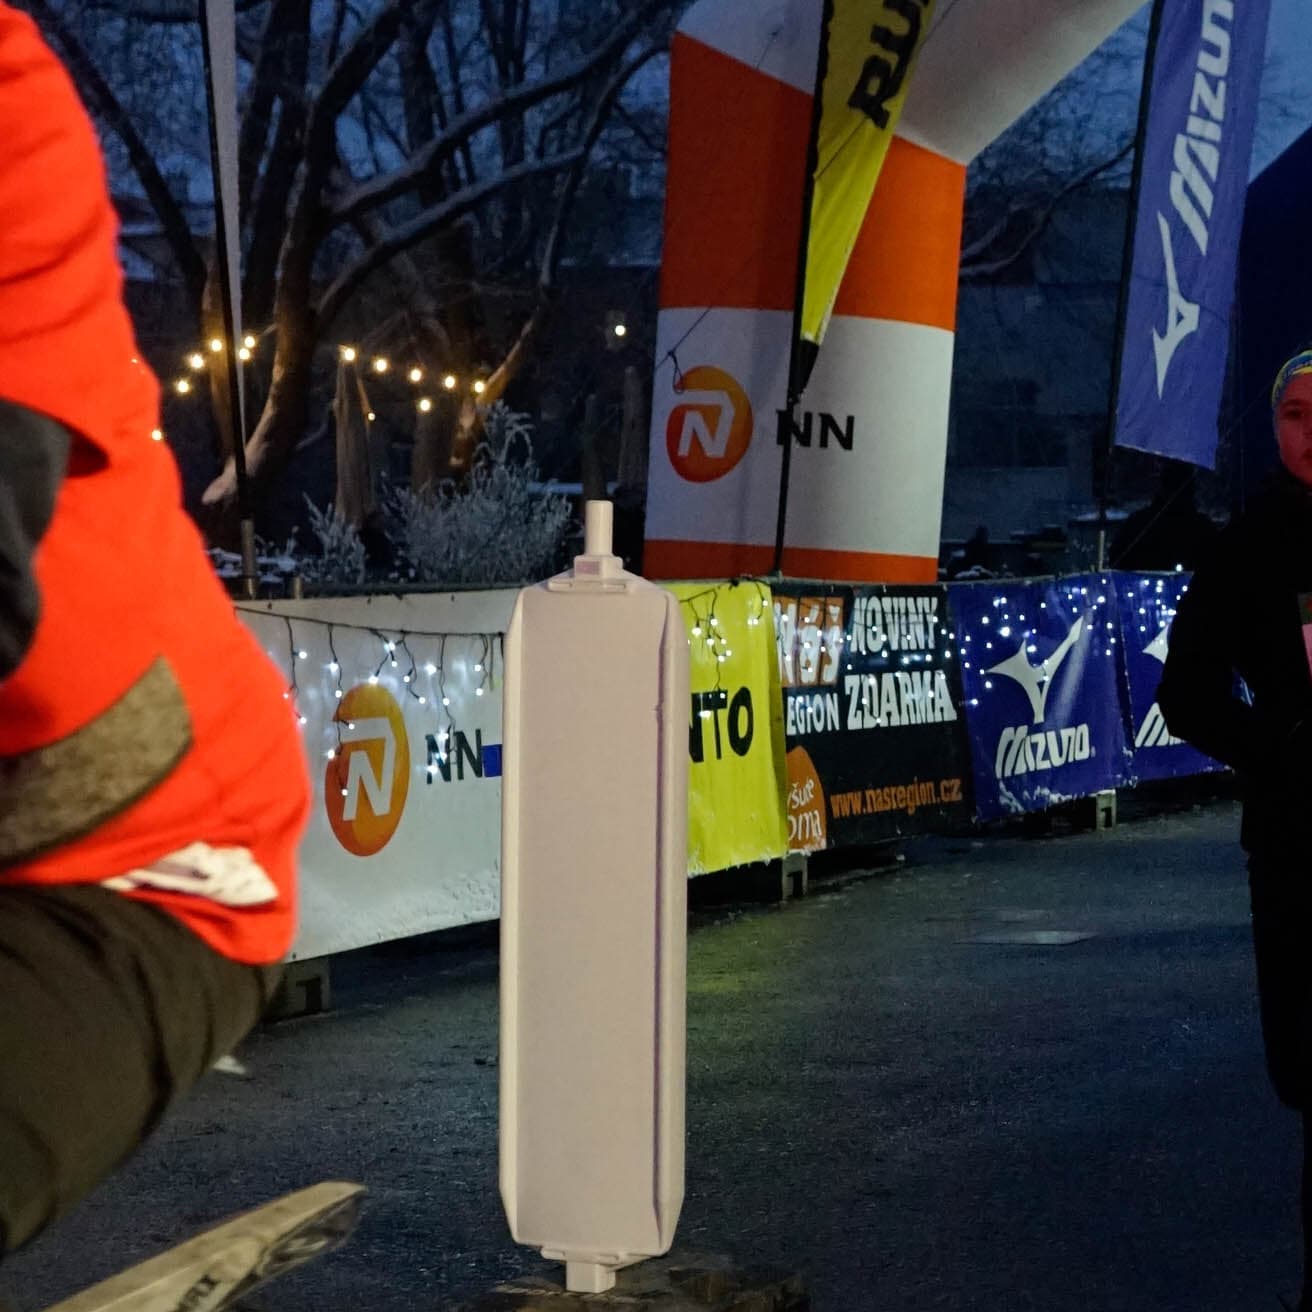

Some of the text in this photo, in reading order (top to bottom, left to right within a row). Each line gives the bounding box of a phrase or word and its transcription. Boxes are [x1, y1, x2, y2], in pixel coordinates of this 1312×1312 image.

[776, 409, 855, 451] NN
[850, 595, 939, 654] NOVINY
[689, 687, 754, 763] NTO
[786, 691, 840, 737] EGION
[844, 670, 958, 731] ZDARMA
[425, 729, 483, 784] NN
[830, 776, 964, 820] www.nasregion.cz
